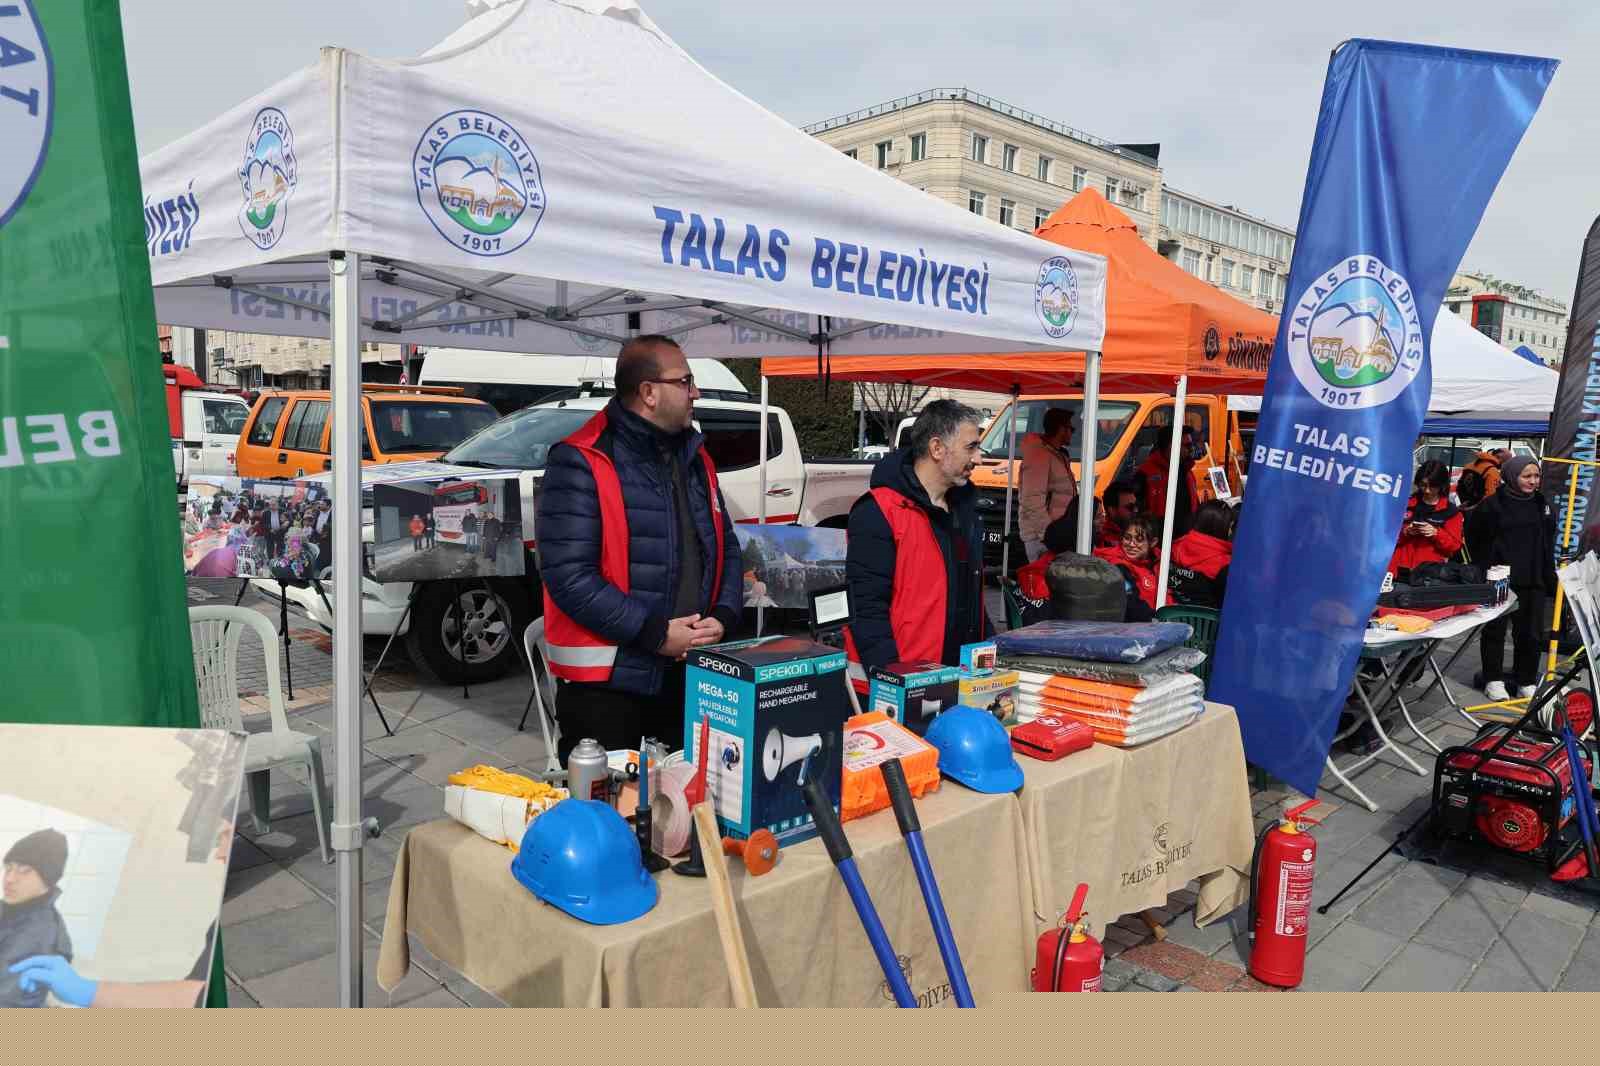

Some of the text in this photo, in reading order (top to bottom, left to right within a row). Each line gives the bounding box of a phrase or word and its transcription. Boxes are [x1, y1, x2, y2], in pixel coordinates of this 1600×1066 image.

[419, 127, 449, 190] TALAS
[144, 178, 200, 257] İYESİ
[462, 234, 502, 251] 1907
[653, 206, 990, 314] TALAS BELEDİYESİ
[1291, 273, 1338, 342] TALAS
[1321, 388, 1361, 405] 1907
[1294, 423, 1371, 457] TALAS
[1253, 445, 1403, 498] BELEDİYESİ
[698, 656, 741, 677] SPEKON
[759, 663, 808, 681] SPEKON
[698, 681, 739, 704] MEGA-50
[759, 682, 809, 699] RECHARGEABLE
[759, 690, 817, 709] HAND MEGAPHONE
